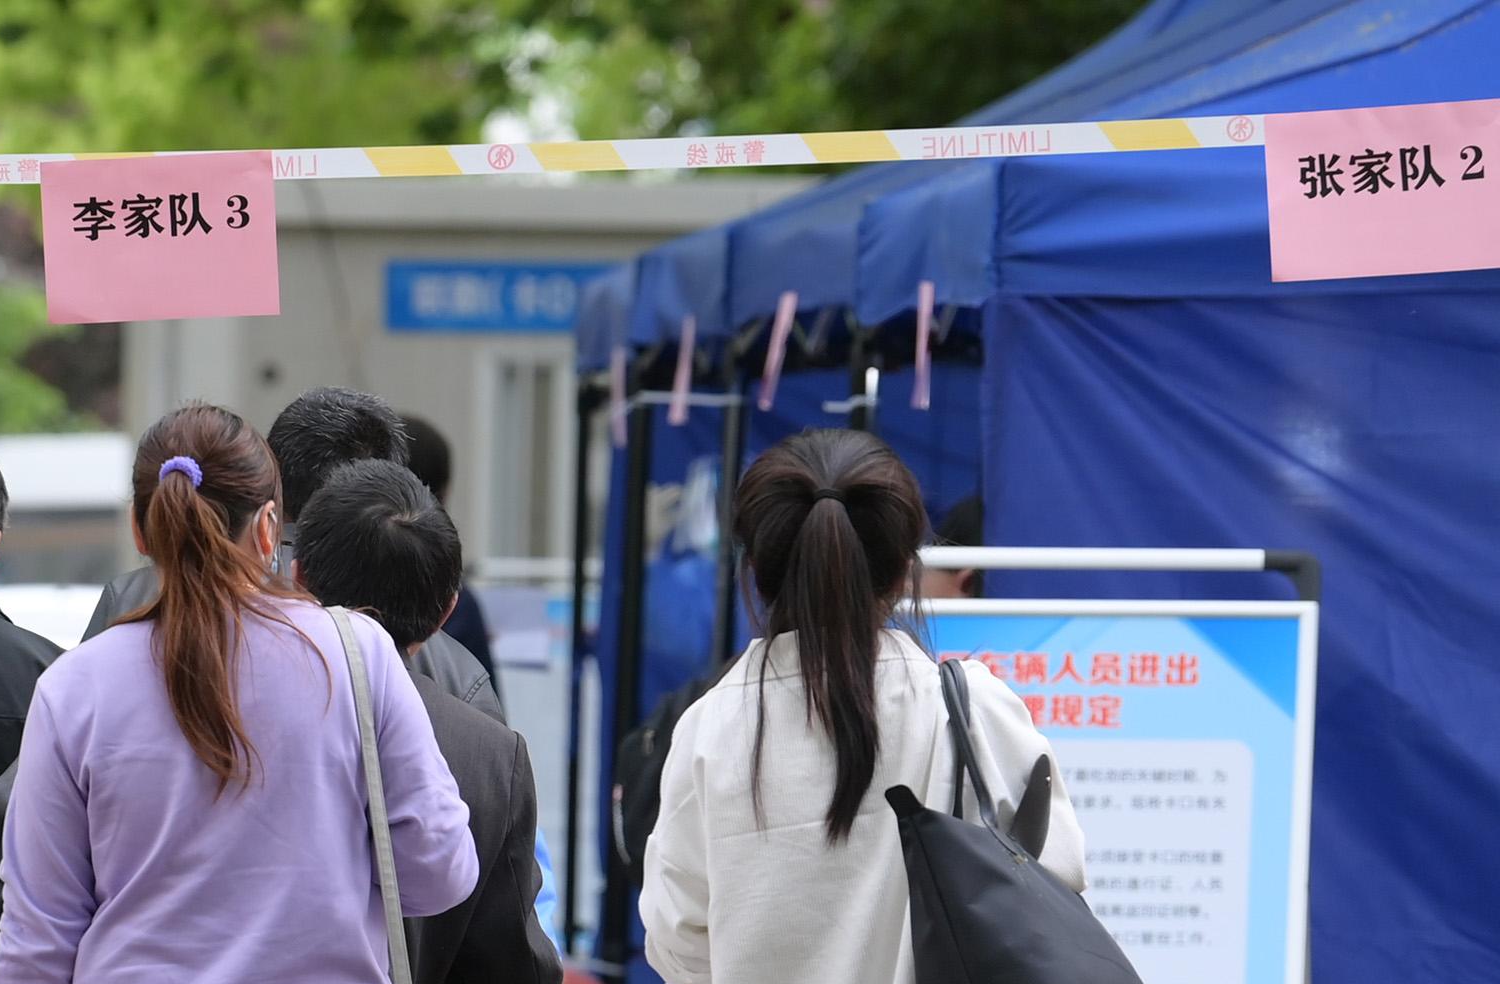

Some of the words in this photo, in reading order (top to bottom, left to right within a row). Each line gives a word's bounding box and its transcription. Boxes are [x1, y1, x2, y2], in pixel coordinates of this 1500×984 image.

[1297, 144, 1447, 200] 张家队
[1459, 144, 1486, 181] 2
[71, 191, 213, 241] 李家队
[226, 194, 250, 229] 3
